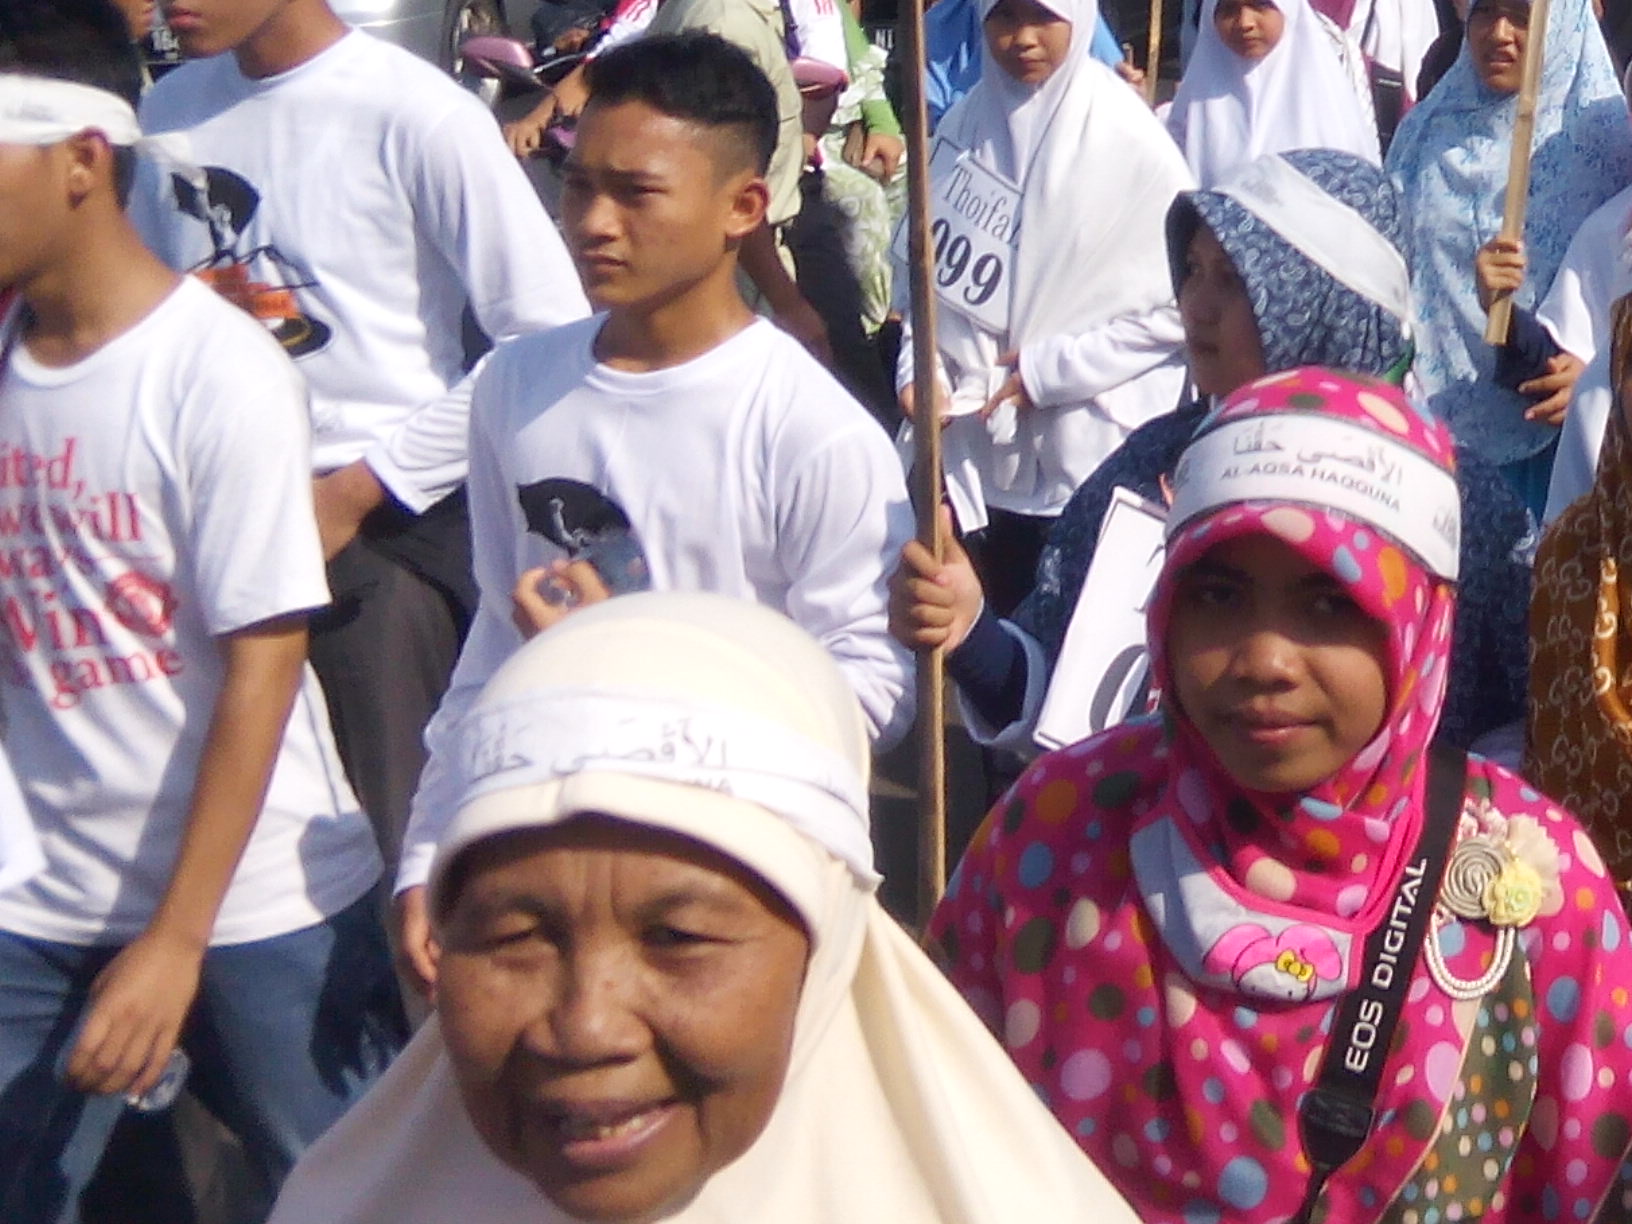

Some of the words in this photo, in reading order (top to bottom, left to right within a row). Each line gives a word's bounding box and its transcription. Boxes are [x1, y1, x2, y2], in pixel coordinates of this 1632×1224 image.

[944, 163, 1012, 244] Thoifa
[1249, 462, 1306, 477] AQSA
[1310, 466, 1401, 513] HAQQUNA
[51, 647, 184, 710] game
[1344, 998, 1384, 1073] EOS
[1371, 857, 1429, 991] DIGITAL
